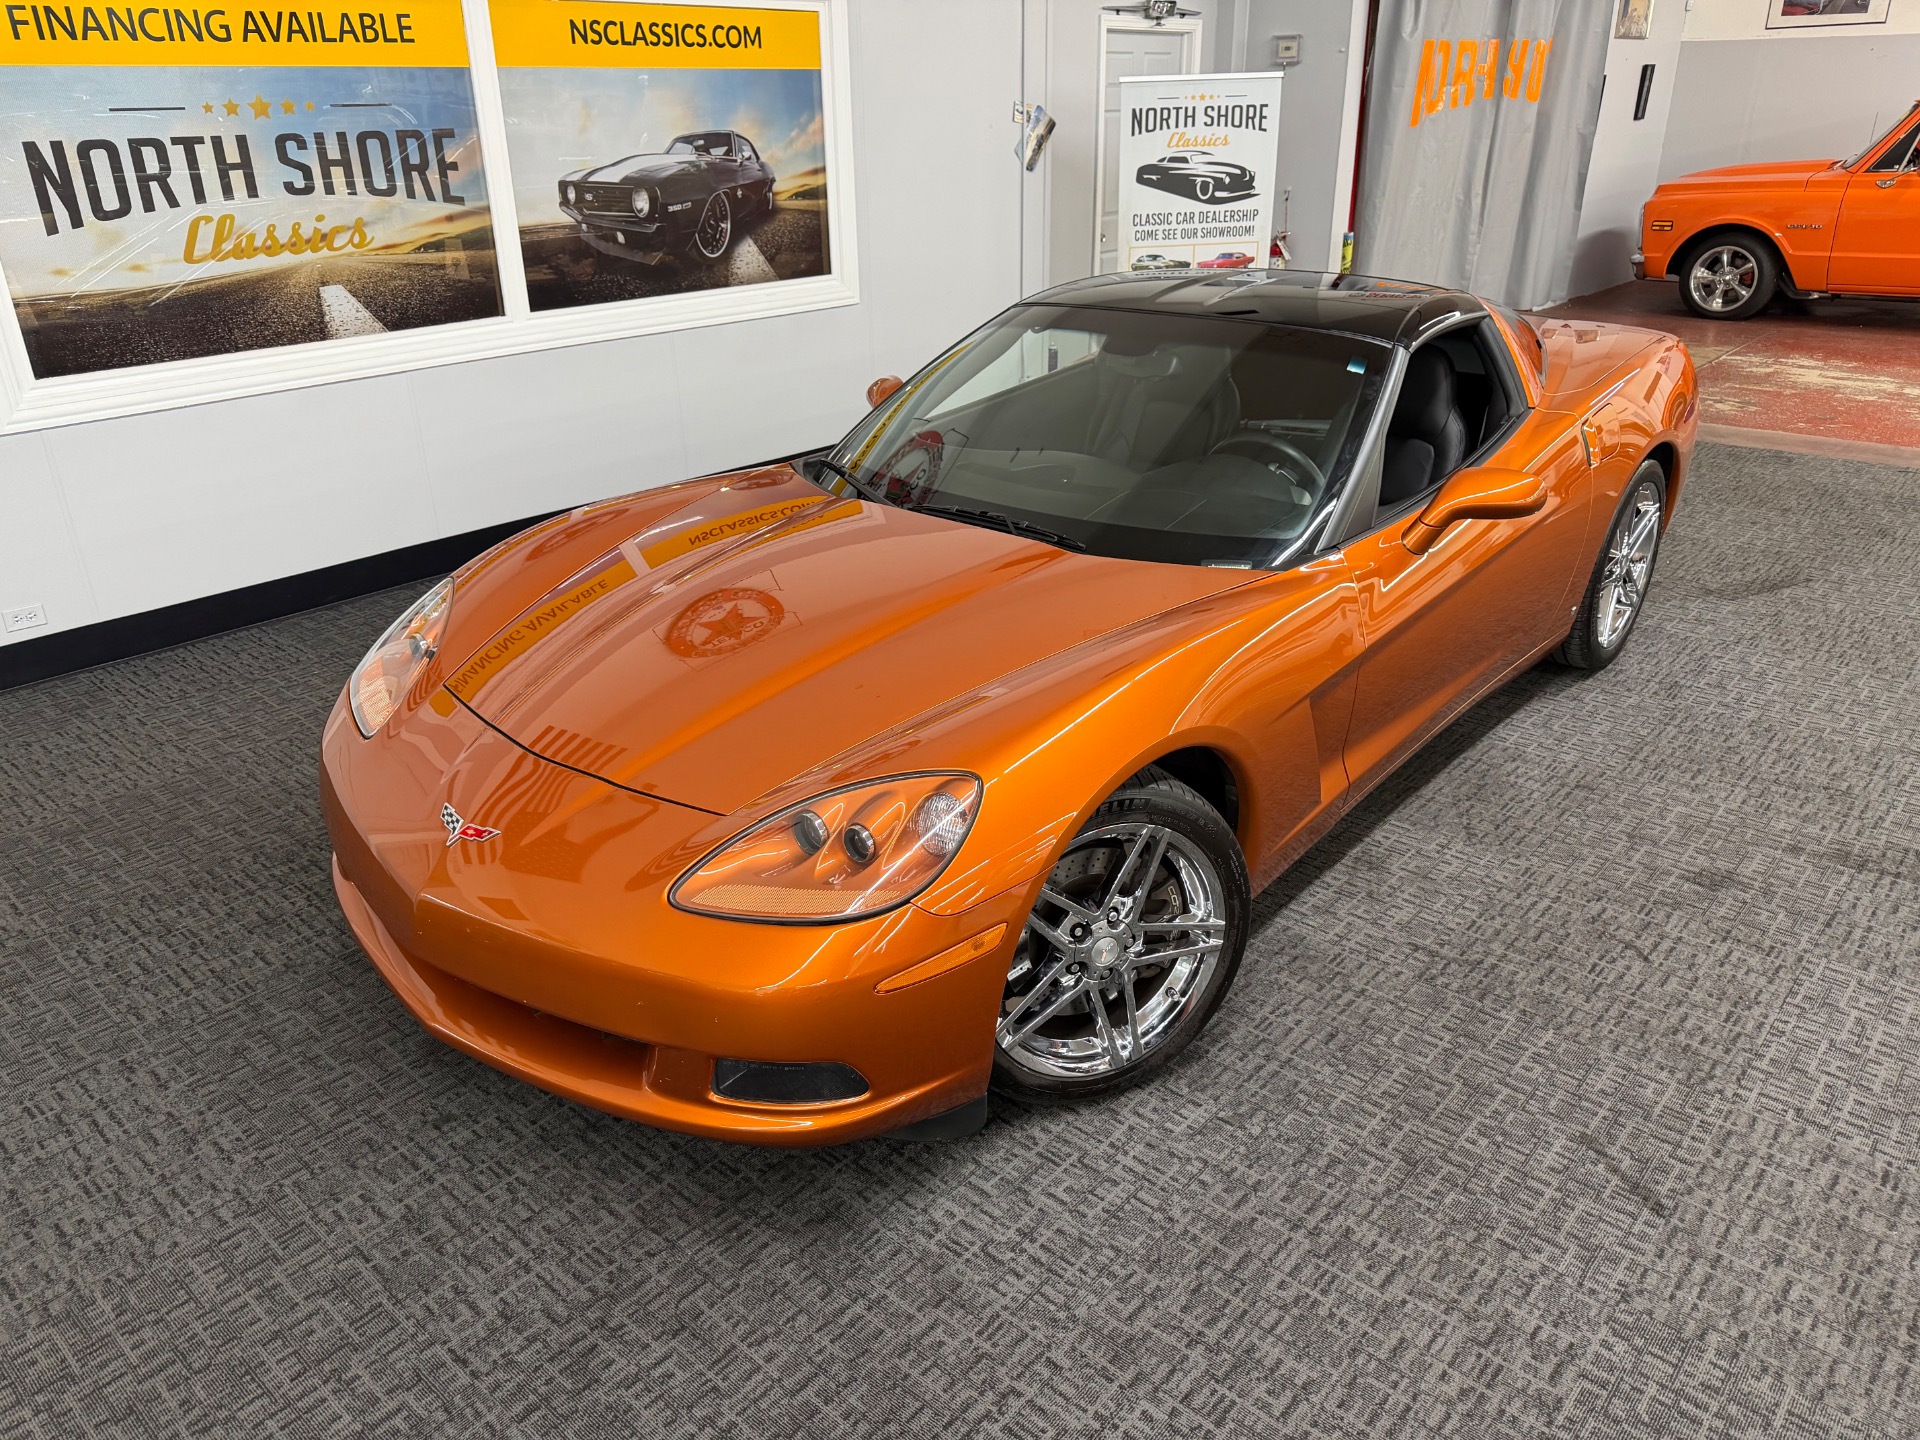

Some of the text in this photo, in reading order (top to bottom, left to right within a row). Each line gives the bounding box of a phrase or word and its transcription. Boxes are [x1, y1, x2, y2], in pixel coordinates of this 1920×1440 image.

[6, 5, 416, 44] FINANCING AVAILABLE
[569, 19, 763, 49] NSCLASSICS.COM
[1131, 103, 1269, 137] NORTH SHORE
[1166, 131, 1230, 148] Classics
[21, 128, 466, 237] NORTH SHORE
[1132, 209, 1259, 227] CLASSIC CAR DEALERSHIP
[1134, 225, 1255, 242] COME SEE OUR SHOWROOM!
[183, 213, 375, 265] Classics
